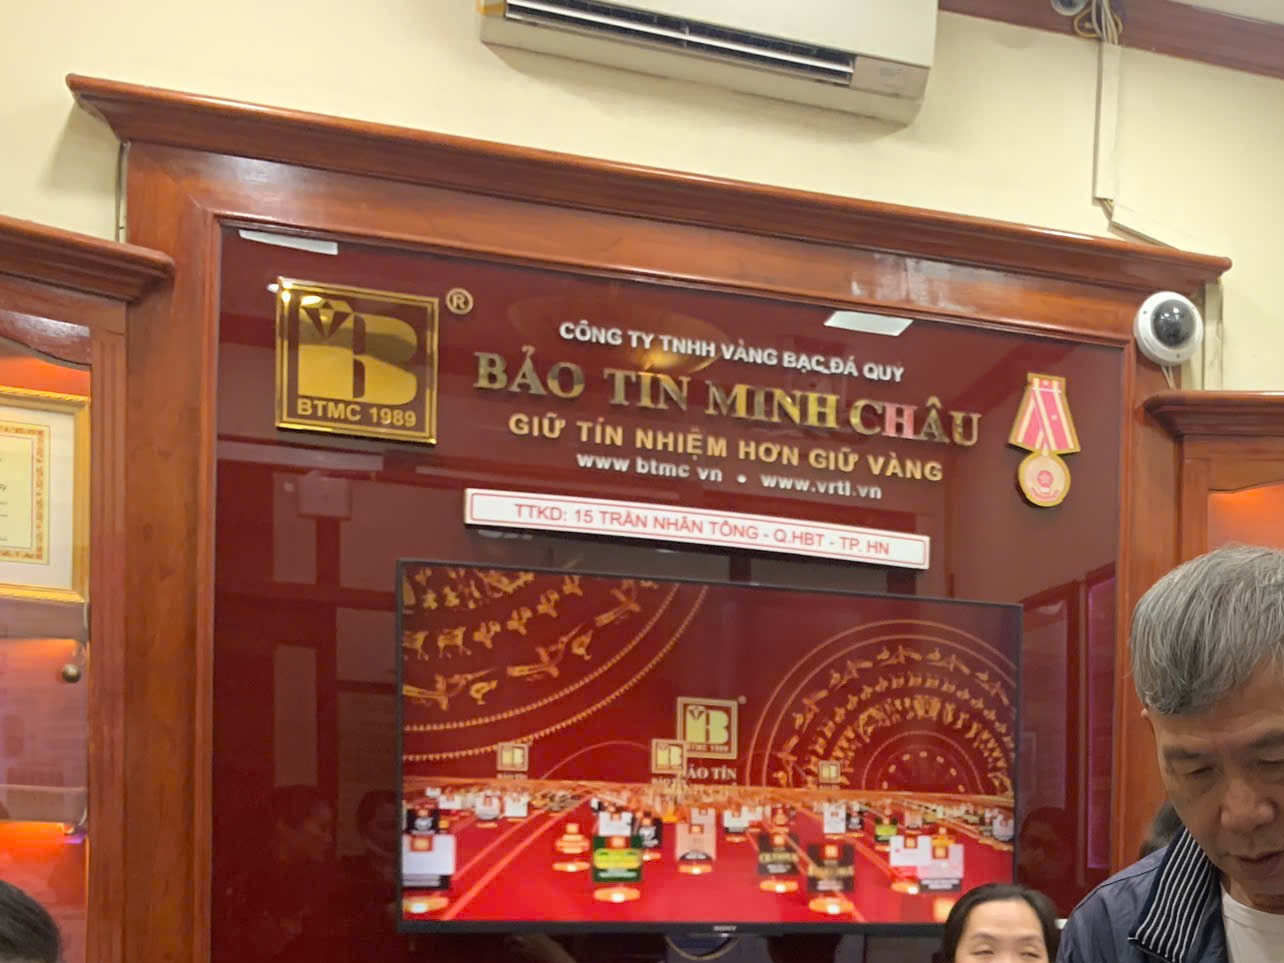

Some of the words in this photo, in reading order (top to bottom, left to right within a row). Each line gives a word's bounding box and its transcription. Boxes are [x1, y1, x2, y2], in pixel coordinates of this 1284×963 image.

[559, 320, 623, 346] CÔNG
[628, 330, 655, 349] TY
[660, 334, 716, 357] TNHH
[721, 339, 778, 366] VÀNG
[782, 351, 828, 374] BẠC
[829, 355, 859, 377] ĐÁ
[297, 398, 361, 422] BTMC
[369, 405, 417, 428] 1989
[473, 345, 585, 398] BẢO
[704, 379, 841, 430] MINH
[849, 396, 983, 447] CHÂU
[508, 412, 566, 439] GIỮ
[576, 417, 623, 447] TÍN
[635, 426, 728, 461] NHIỆM
[738, 439, 799, 466] HƠN
[808, 447, 859, 473] GIỮ
[867, 452, 943, 482] VÀNG
[761, 474, 882, 500] www.vrtl.vn
[515, 503, 567, 522] TTKD:
[575, 509, 593, 524] 15
[653, 516, 704, 534] NHÂN
[709, 521, 760, 540] TÔNG
[773, 528, 825, 547] Q.HBT
[840, 536, 863, 553] TP.
[867, 540, 890, 556] HN
